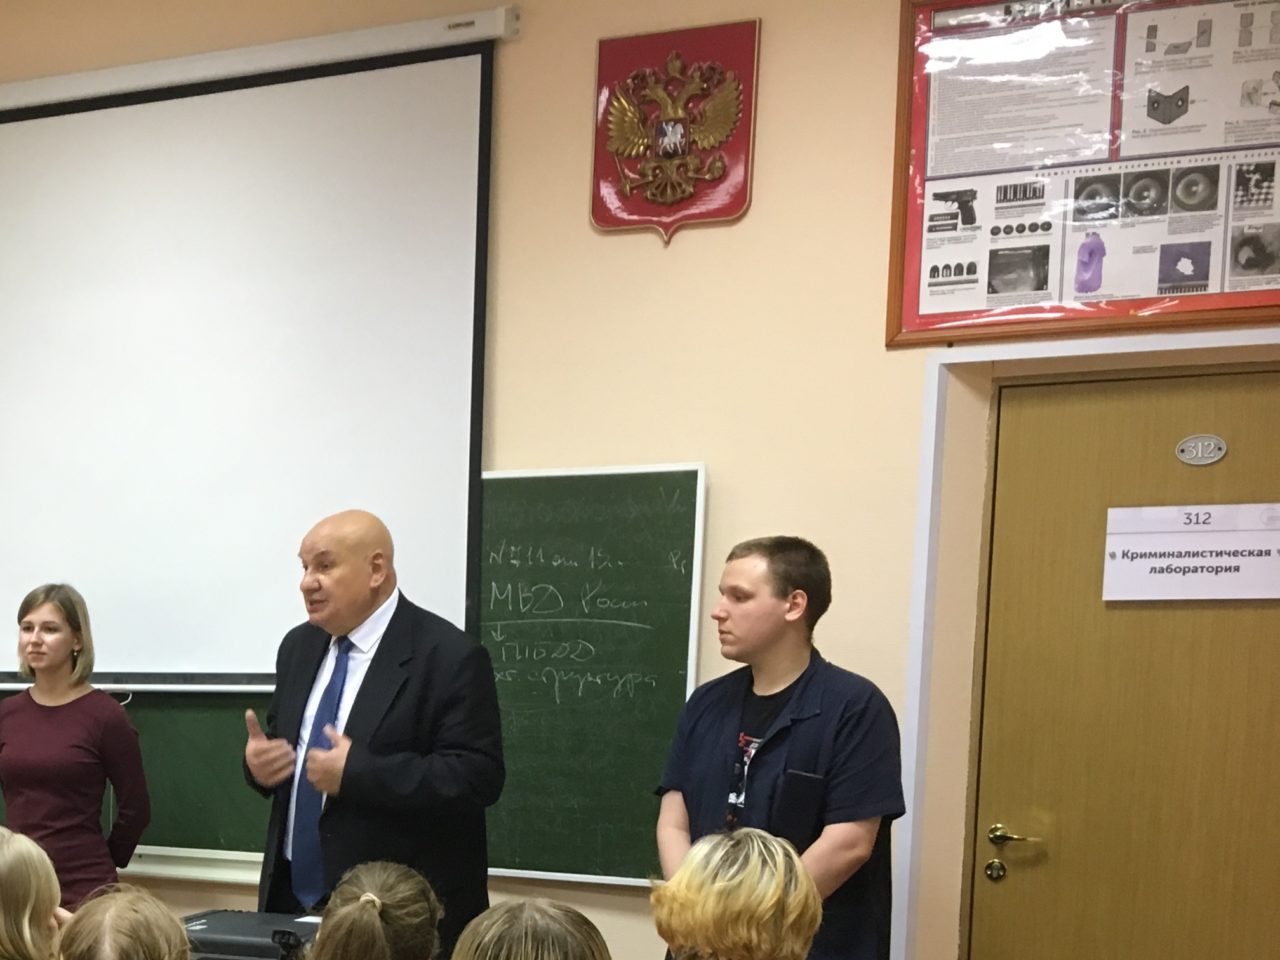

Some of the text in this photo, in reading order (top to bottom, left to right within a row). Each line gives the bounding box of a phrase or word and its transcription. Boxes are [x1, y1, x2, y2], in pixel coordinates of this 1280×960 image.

[1185, 440, 1217, 459] 312
[1183, 512, 1212, 526] 312
[1121, 548, 1272, 561] Криминалистическая
[1149, 563, 1241, 576] лаборатория
